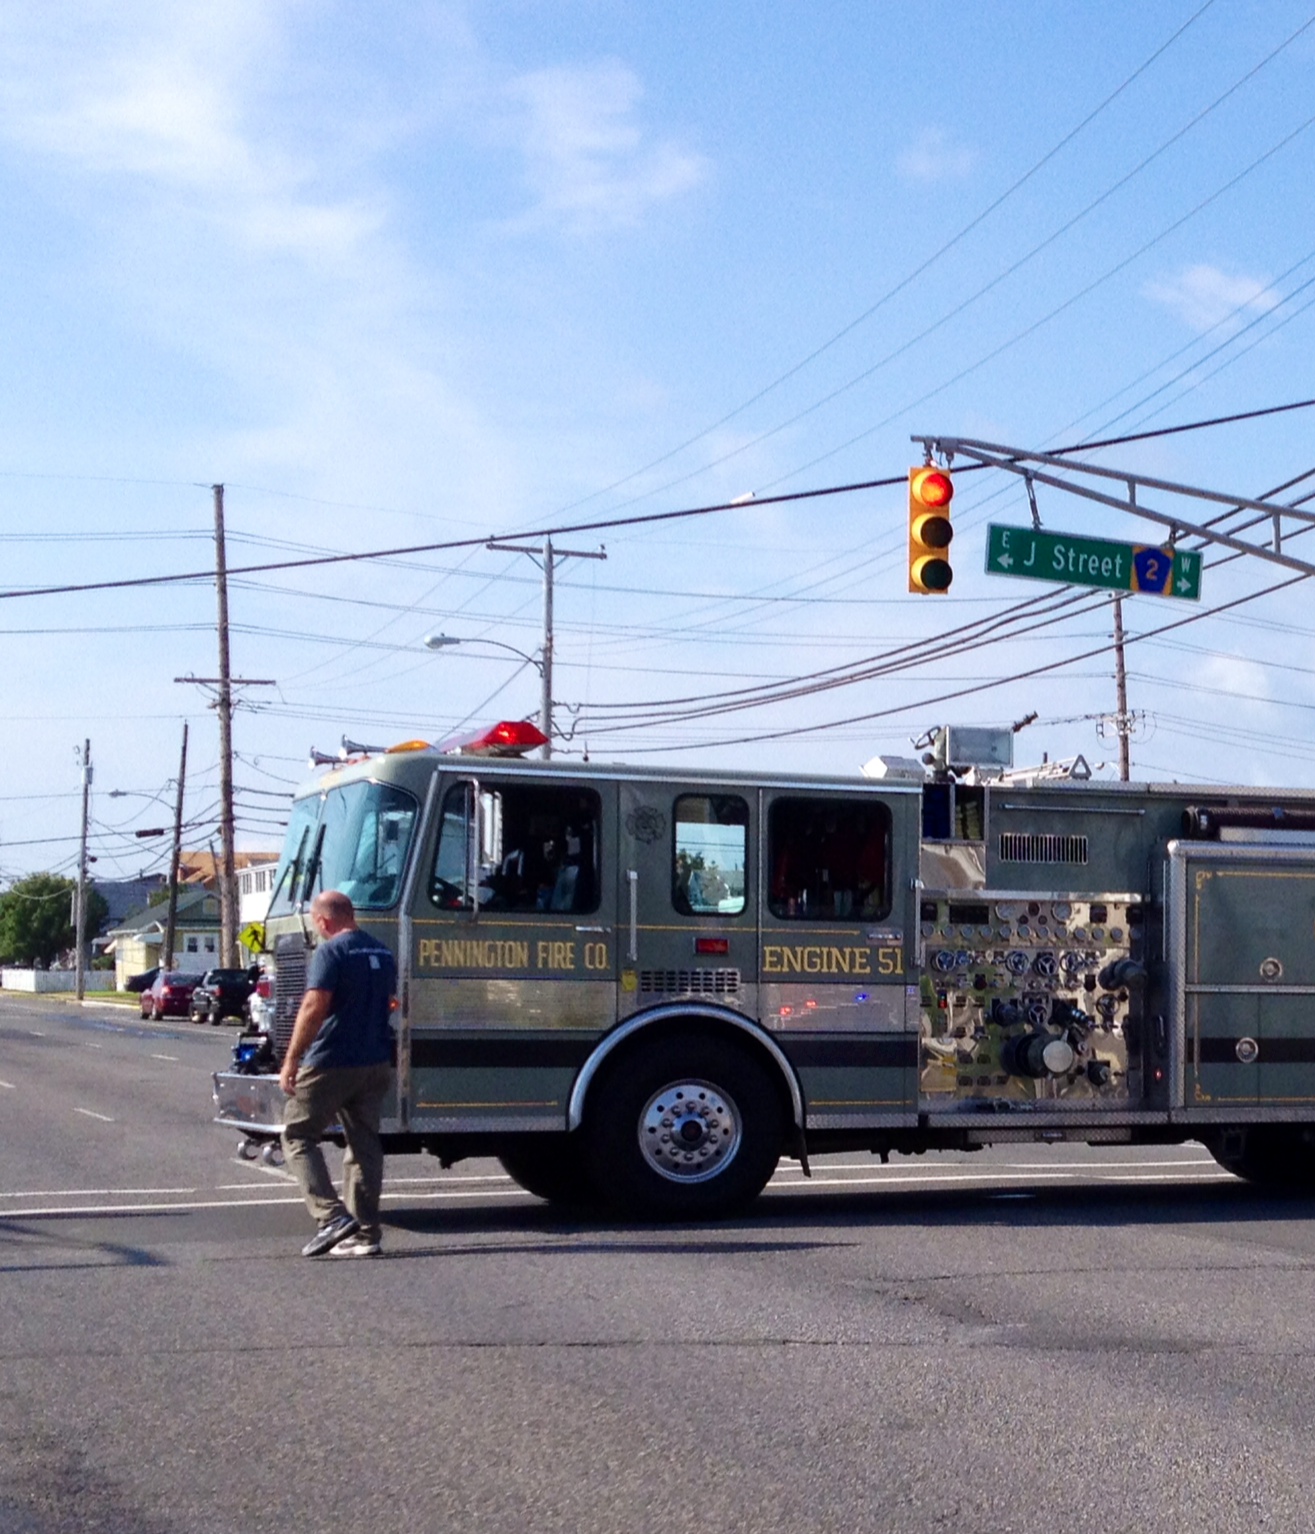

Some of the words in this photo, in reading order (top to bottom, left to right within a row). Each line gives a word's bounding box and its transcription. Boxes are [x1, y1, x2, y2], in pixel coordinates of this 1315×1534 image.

[1002, 530, 1011, 548] E
[1023, 541, 1036, 566] J
[1052, 544, 1123, 579] Street
[1145, 559, 1159, 580] 2
[1180, 556, 1192, 573] W
[418, 938, 529, 969] PENNINGTON
[536, 941, 575, 969] FIRE
[763, 945, 871, 974] ENGINE
[878, 947, 904, 974] 51
